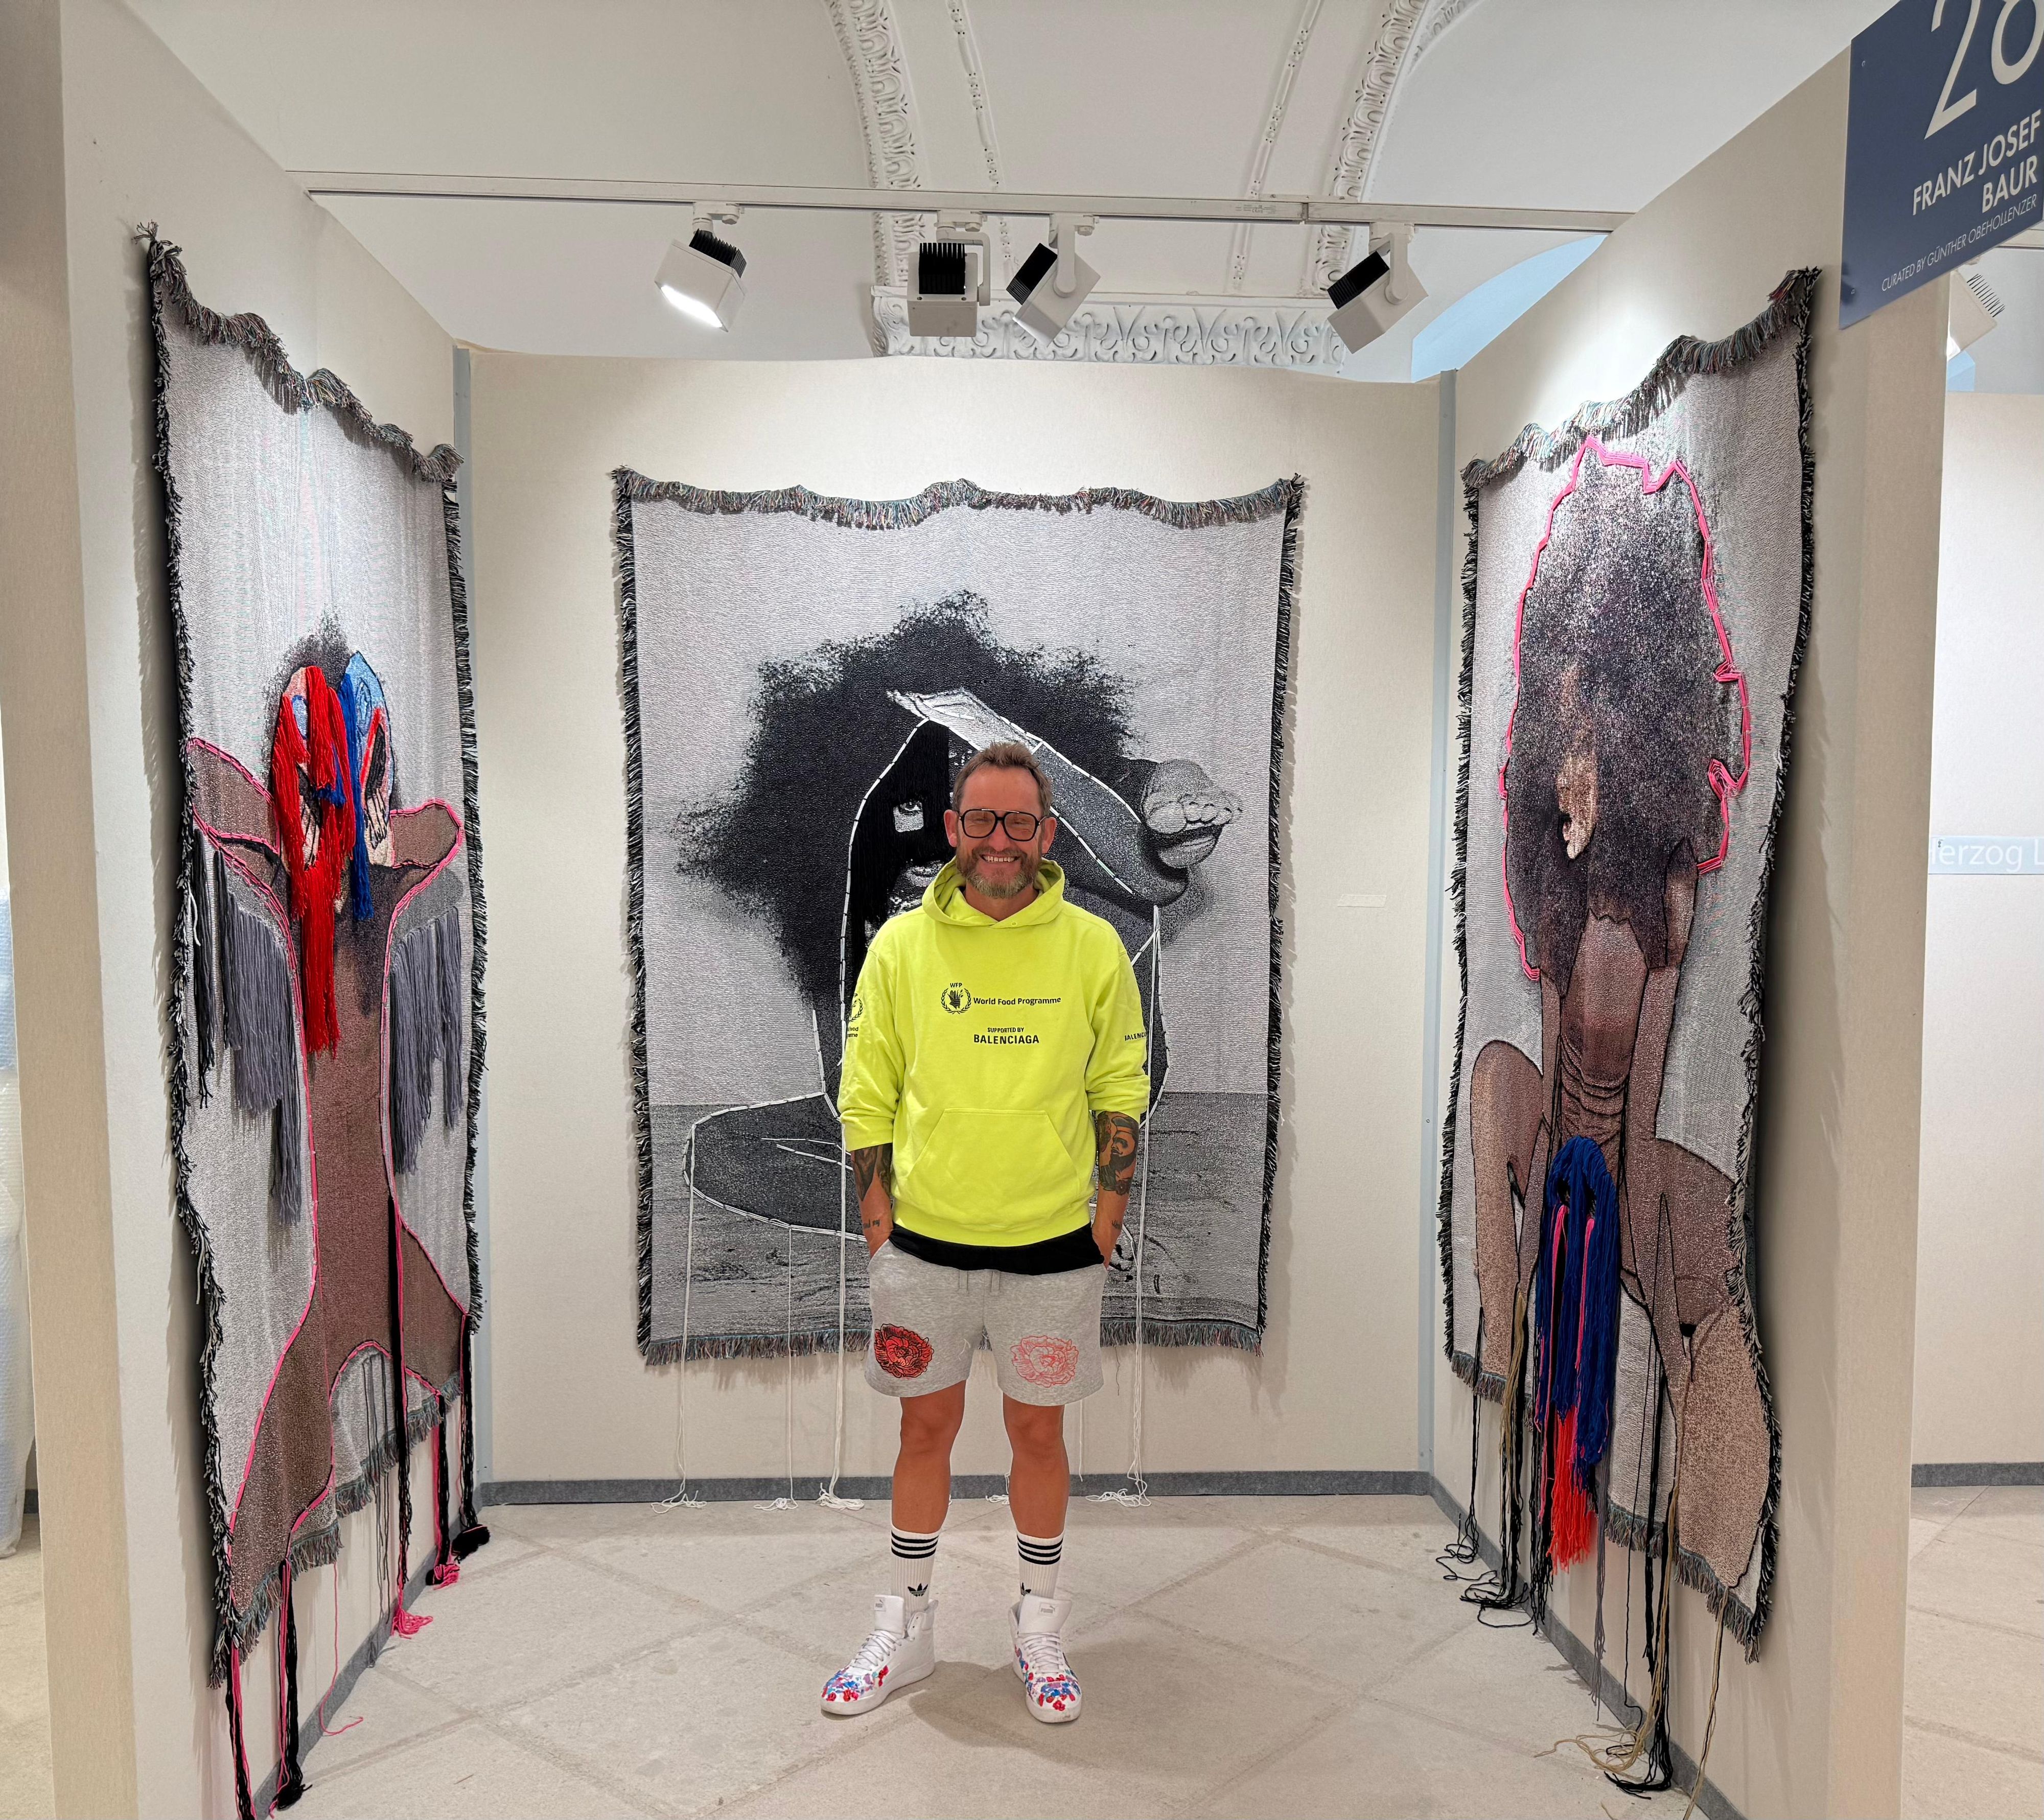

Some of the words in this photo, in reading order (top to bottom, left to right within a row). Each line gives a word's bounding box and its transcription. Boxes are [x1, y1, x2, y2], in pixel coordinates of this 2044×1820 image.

[1913, 151, 1976, 216] FRANZ
[1978, 109, 2041, 175] JOSEF
[1982, 155, 2038, 214] BAUR
[1882, 263, 1915, 292] CURATED
[1916, 256, 1926, 273] BY
[1927, 234, 1967, 266] GÜNTHER
[1968, 194, 2037, 243] OBEHOLLENZER
[973, 997, 996, 1005] World
[1017, 997, 1061, 1006] Programme
[973, 1034, 1039, 1044] BALENCIAGA
